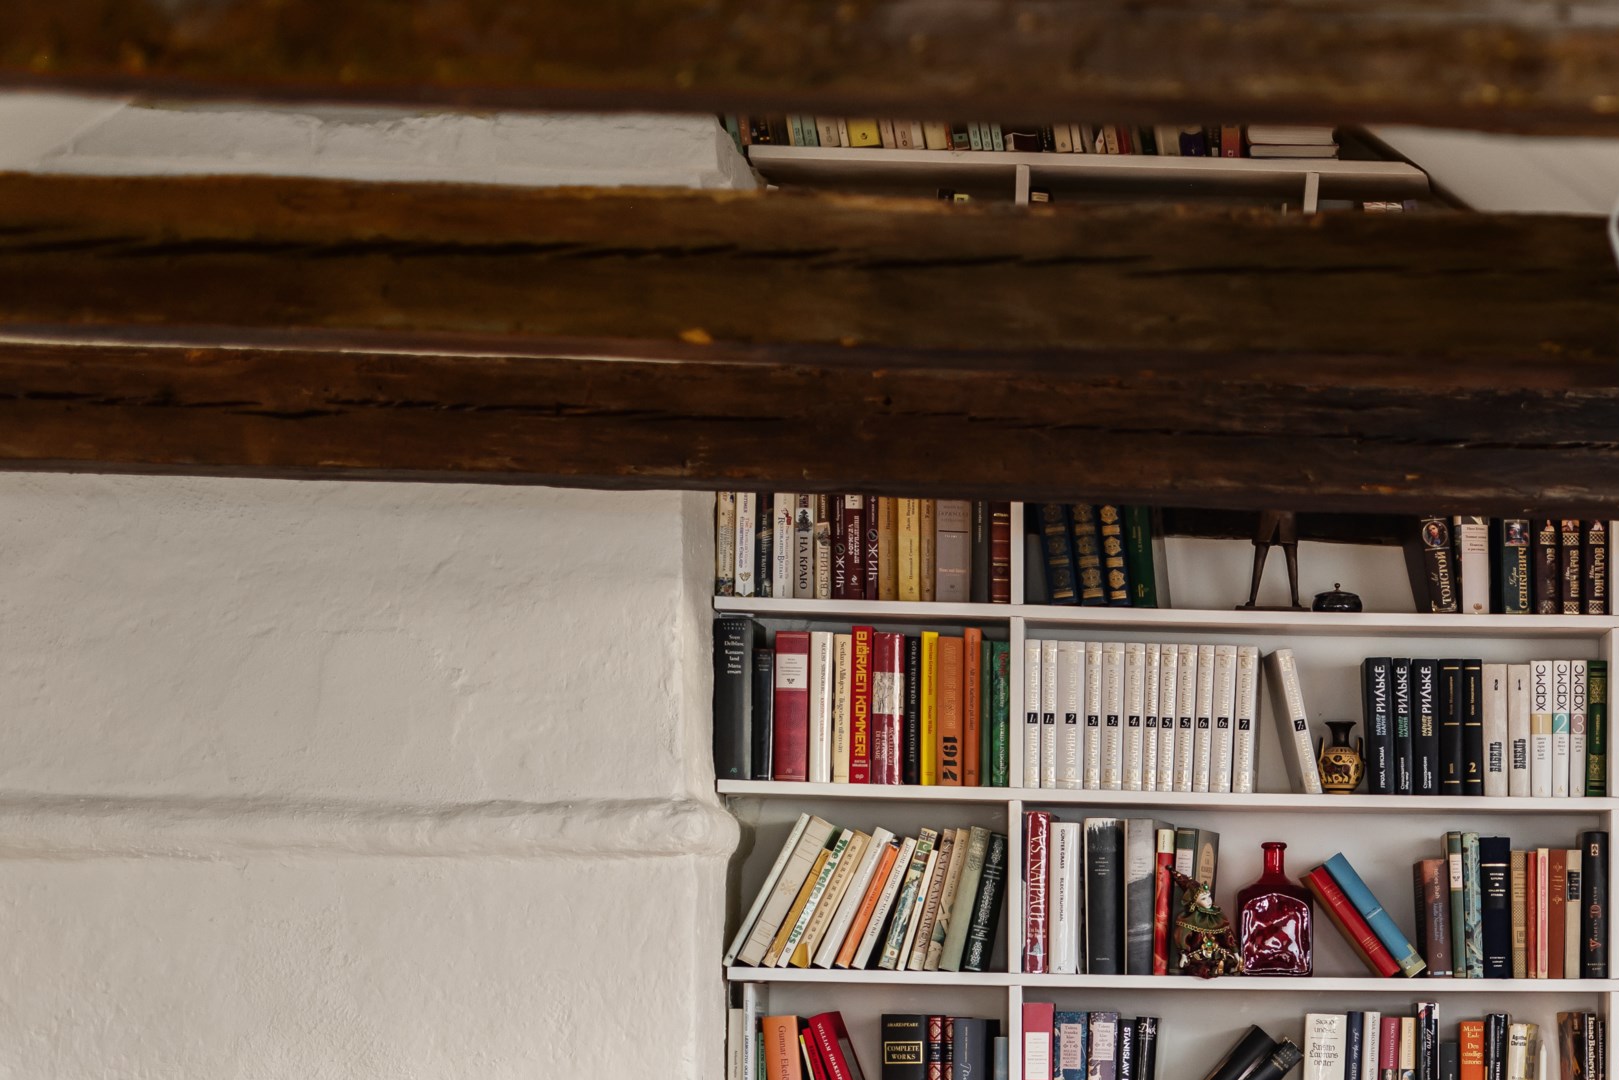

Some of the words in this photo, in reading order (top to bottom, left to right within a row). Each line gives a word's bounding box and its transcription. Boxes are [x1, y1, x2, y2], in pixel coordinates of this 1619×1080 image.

[799, 536, 812, 554] НА
[868, 543, 878, 580] ЧИЖ
[799, 556, 813, 590] КРАЮ
[836, 555, 844, 587] ЧИЖ
[1375, 665, 1386, 713] РИЛЬКЕ
[1397, 666, 1407, 713] РИЛЬКЕ
[1421, 666, 1432, 713] РИЛЬКЕ
[943, 735, 958, 781] 1914
[829, 838, 849, 860] The
[809, 861, 836, 899] Twelve
[777, 1025, 788, 1056] Gunnar
[816, 1023, 832, 1052] WILLIAM
[1588, 1017, 1596, 1039] Isaac
[1588, 1040, 1596, 1078] Bashevis
